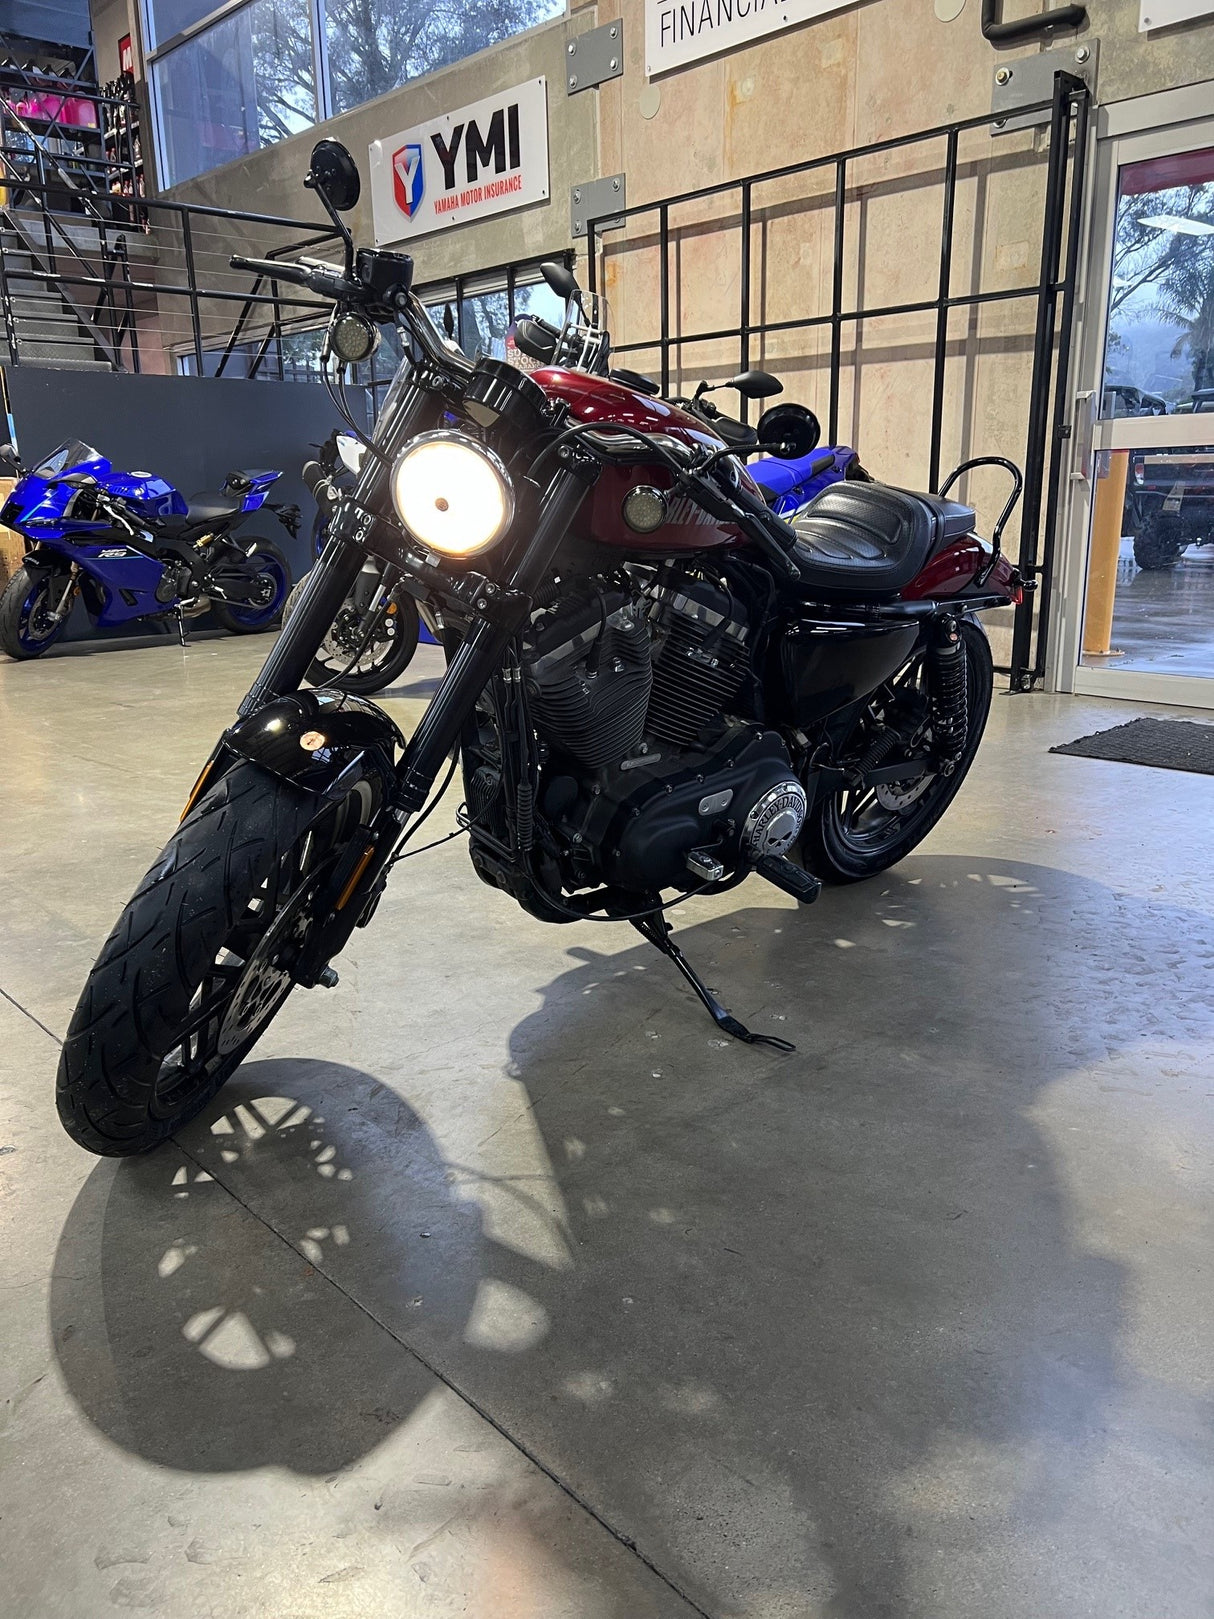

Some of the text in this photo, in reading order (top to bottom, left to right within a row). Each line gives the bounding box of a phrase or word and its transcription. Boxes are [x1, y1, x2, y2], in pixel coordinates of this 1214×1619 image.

[660, 0, 787, 47] FINANC
[430, 103, 521, 190] YMI
[433, 174, 522, 214] YAMAHA MOTOR INSURANCE
